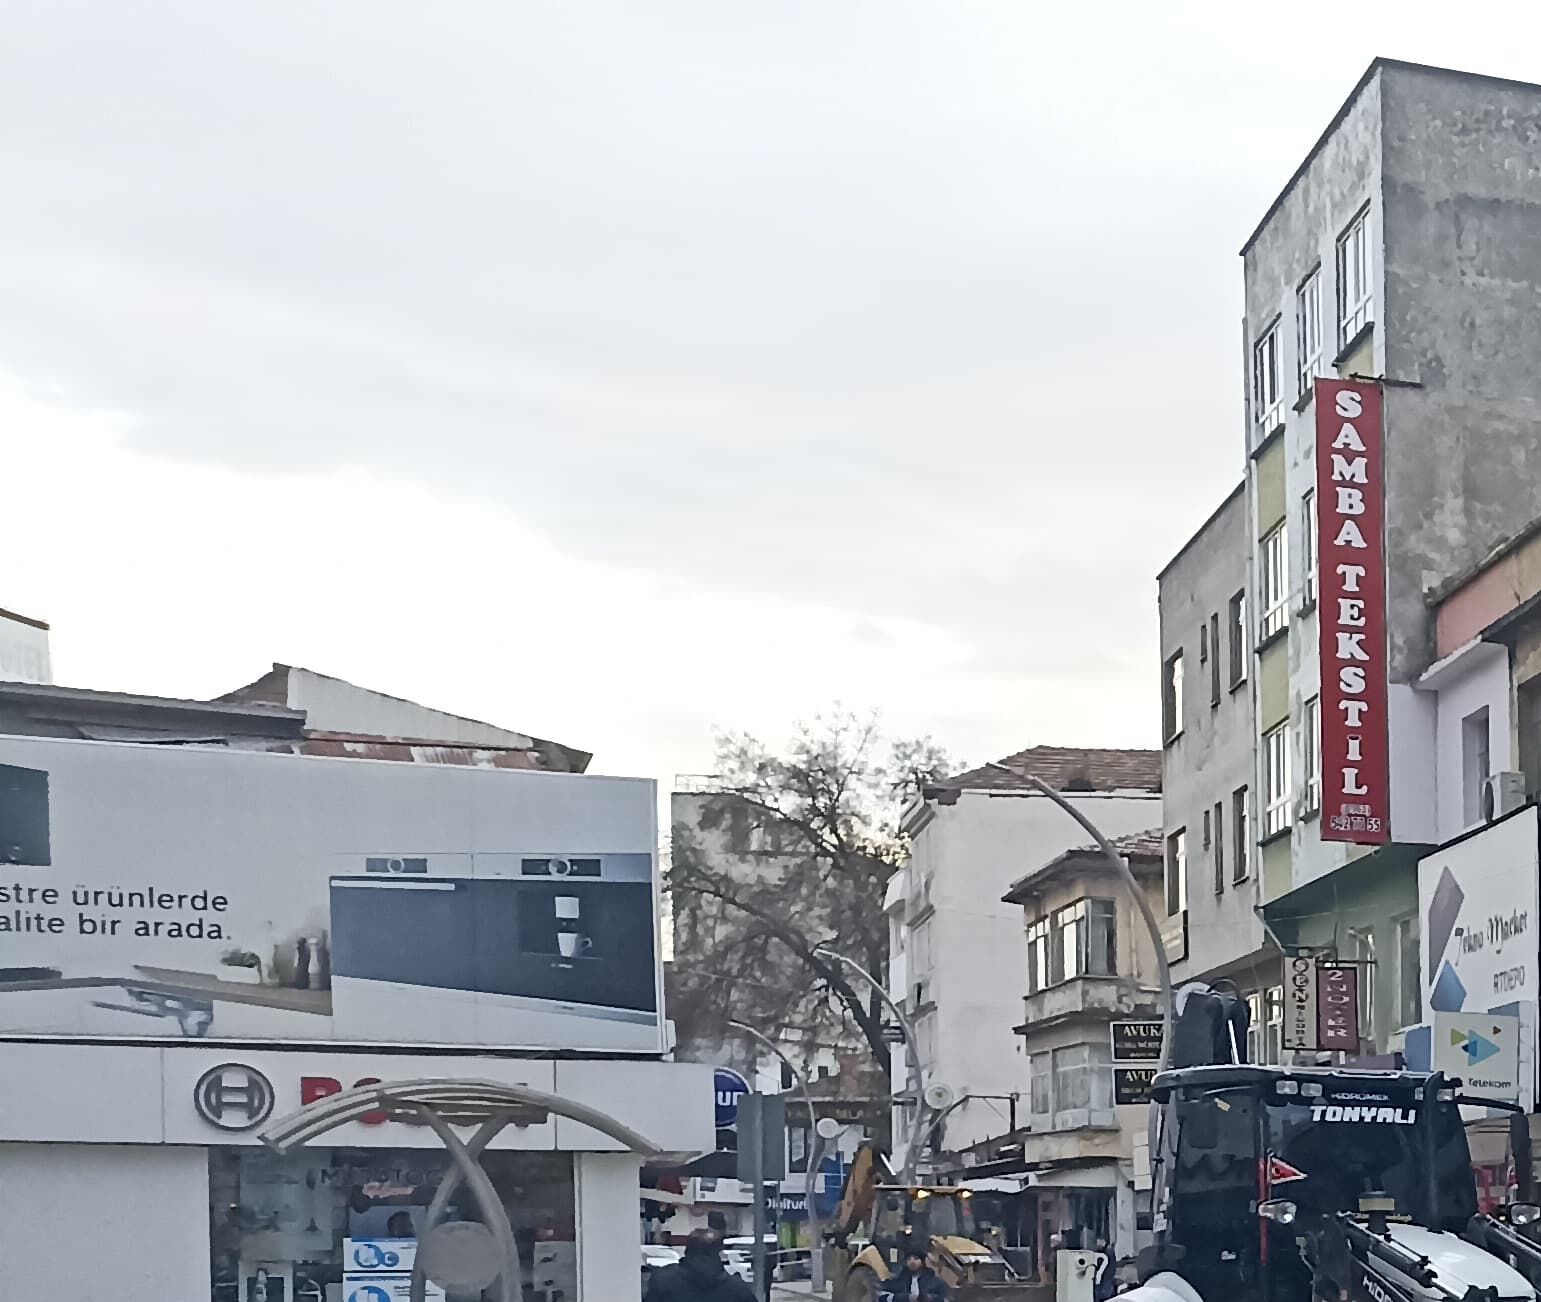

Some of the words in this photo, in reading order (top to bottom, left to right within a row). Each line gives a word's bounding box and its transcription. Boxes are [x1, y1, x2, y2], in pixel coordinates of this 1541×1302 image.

[1331, 390, 1368, 549] SAMBA
[1335, 563, 1370, 796] TEKSTİL
[72, 884, 229, 911] ürünlerde
[79, 912, 121, 936] bir
[134, 917, 232, 940] arada.
[1310, 1105, 1416, 1124] TONYALI
